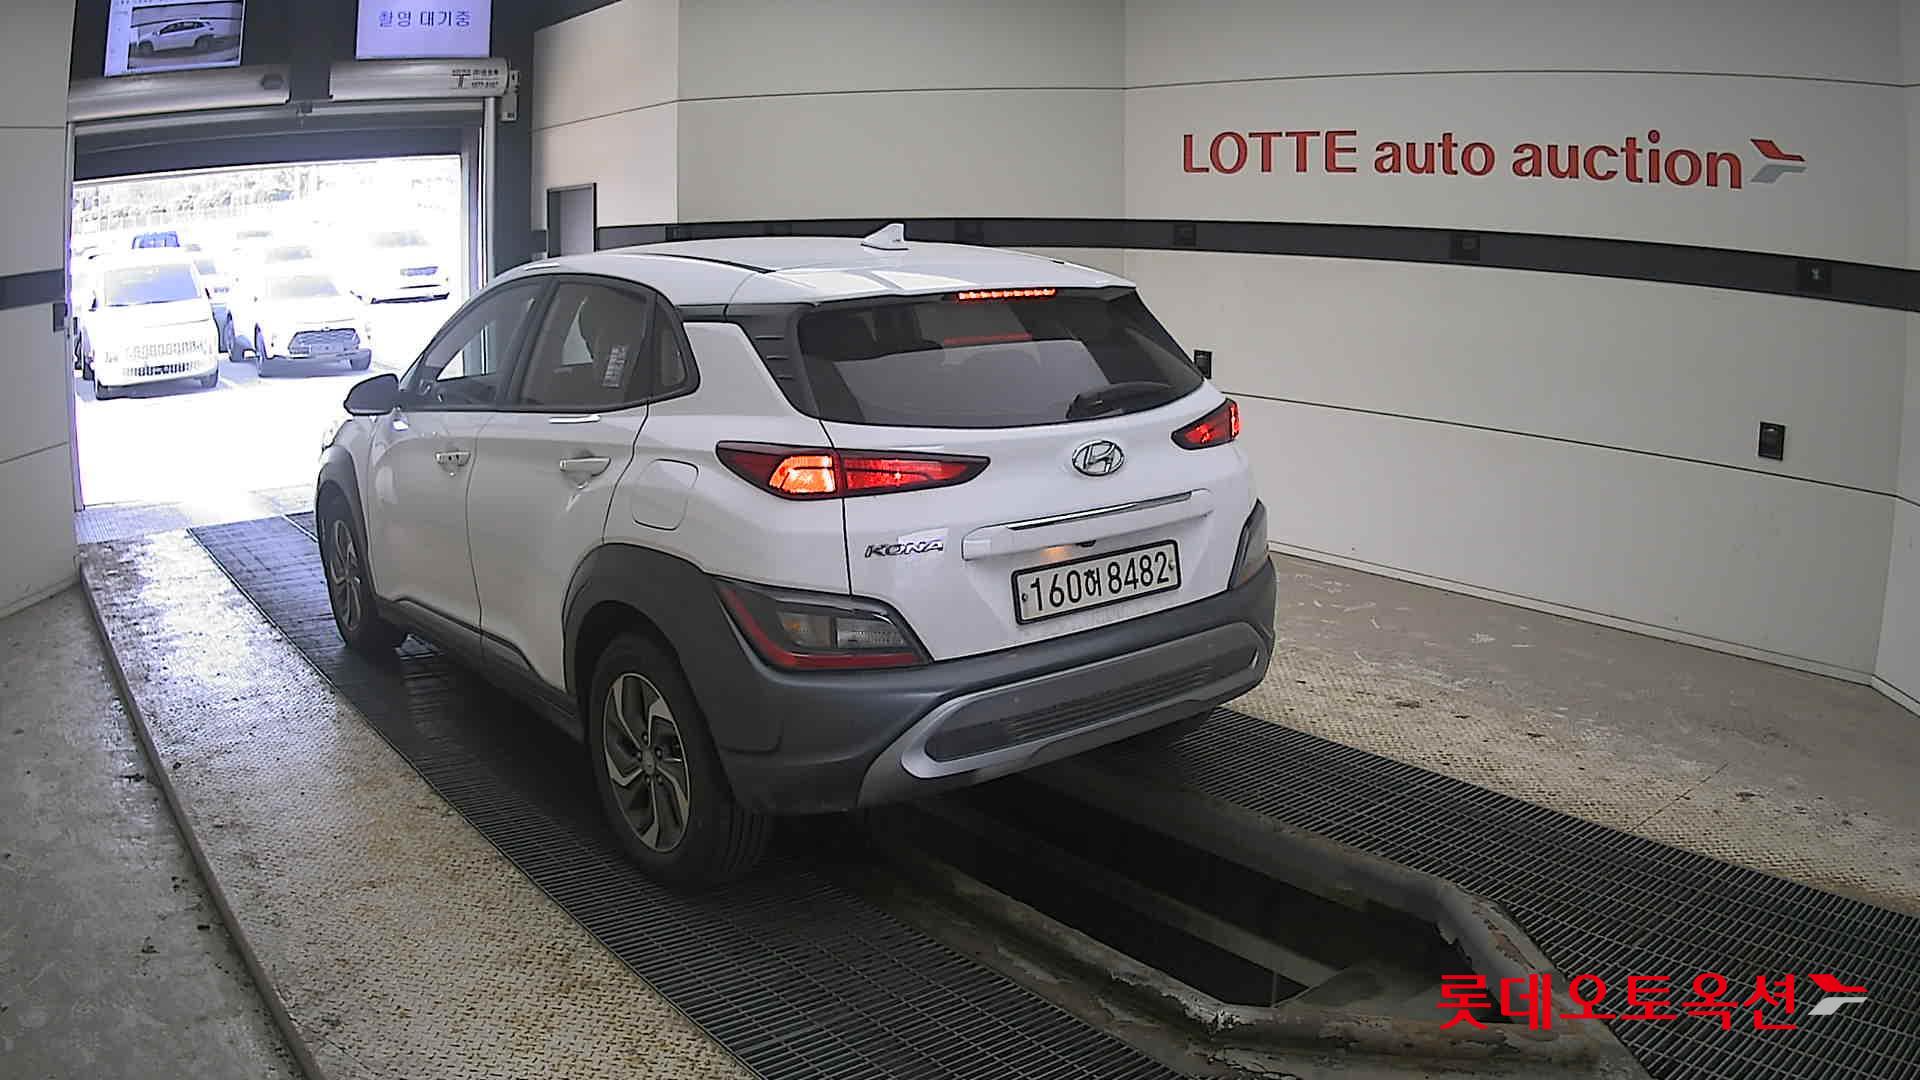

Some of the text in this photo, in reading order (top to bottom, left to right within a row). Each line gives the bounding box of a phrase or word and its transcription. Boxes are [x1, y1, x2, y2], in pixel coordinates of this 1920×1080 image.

[420, 10, 470, 28] 대기중
[1183, 129, 1743, 189] LOTTE auto auction
[864, 540, 944, 558] KONA
